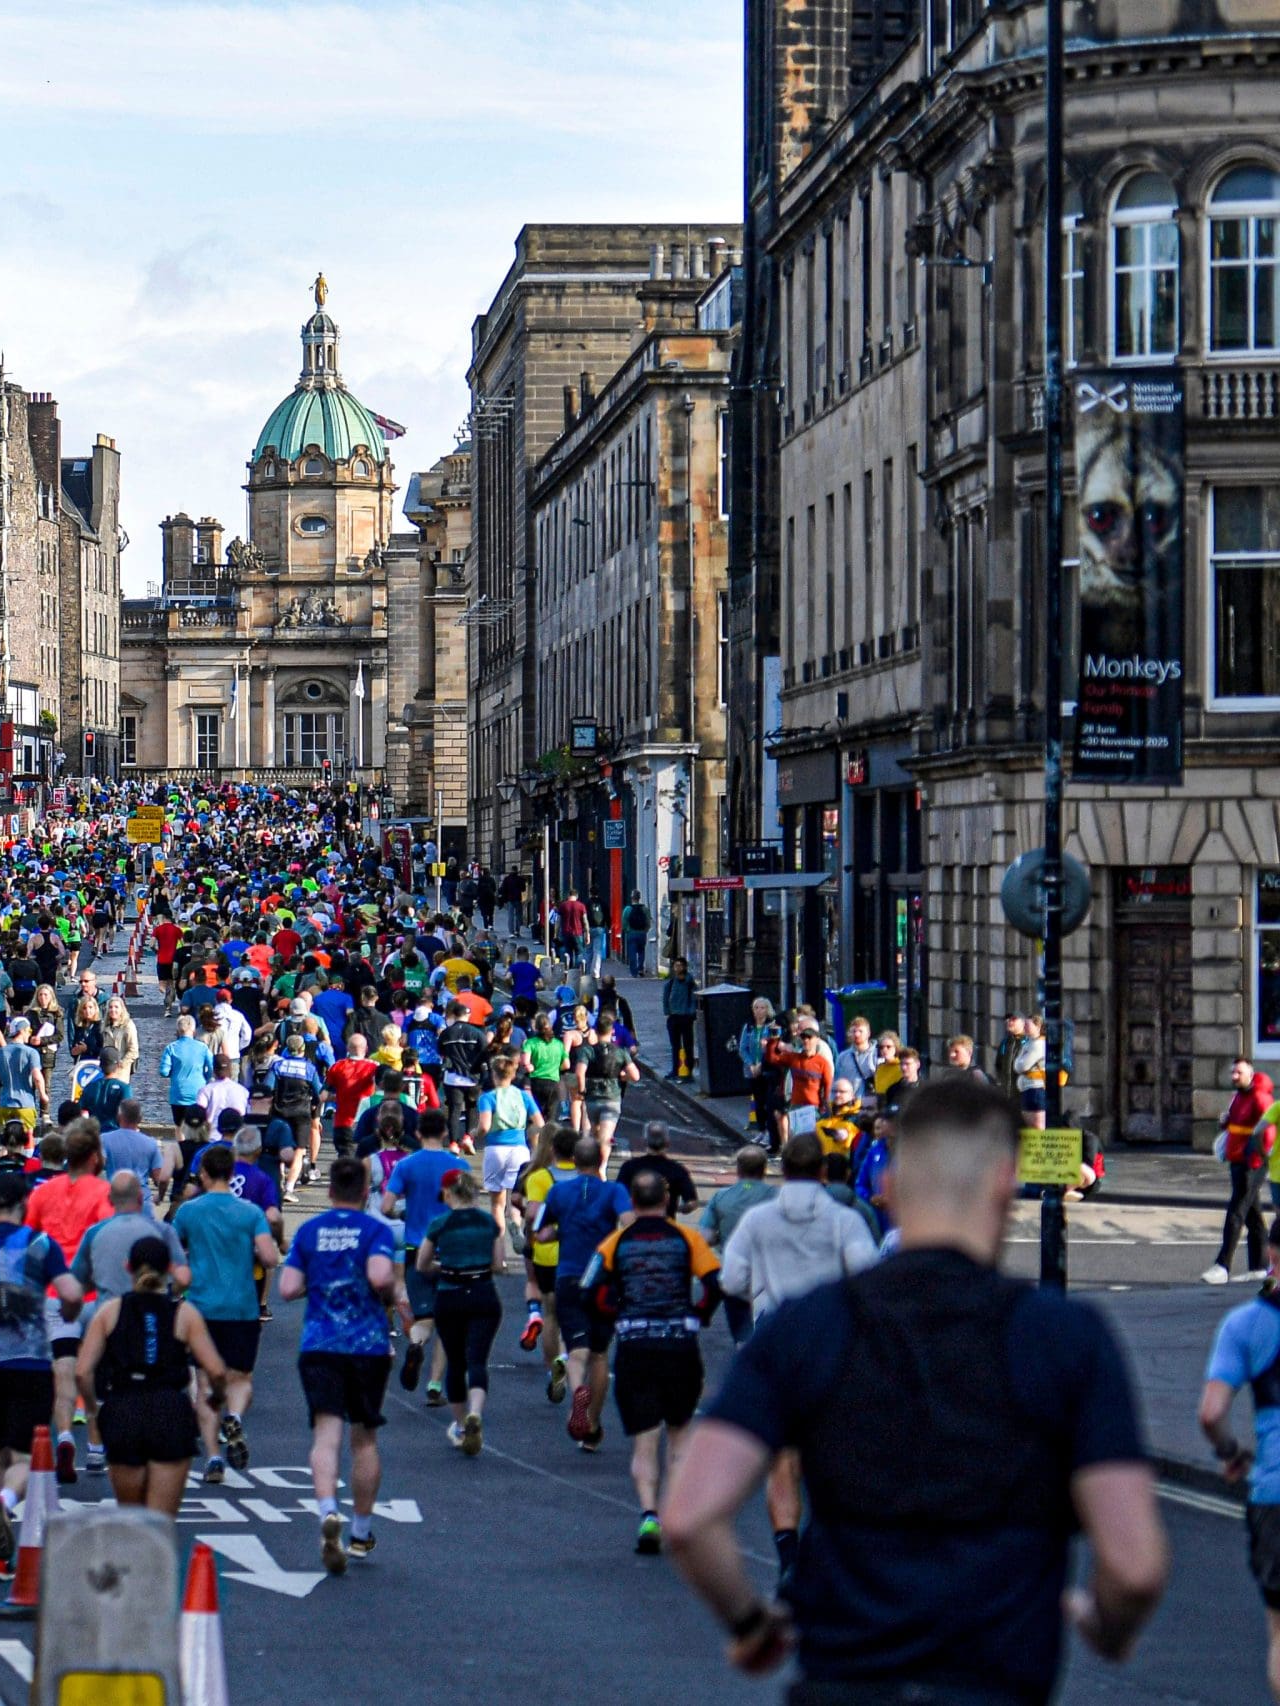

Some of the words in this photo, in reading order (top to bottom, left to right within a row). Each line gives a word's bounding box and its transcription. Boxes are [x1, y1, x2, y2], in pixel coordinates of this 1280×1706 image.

[1133, 383, 1174, 392] National
[1133, 393, 1171, 402] Museum
[1133, 403, 1174, 412] Scotland
[1084, 653, 1181, 685] Monkeys
[1145, 737, 1169, 747] 2025
